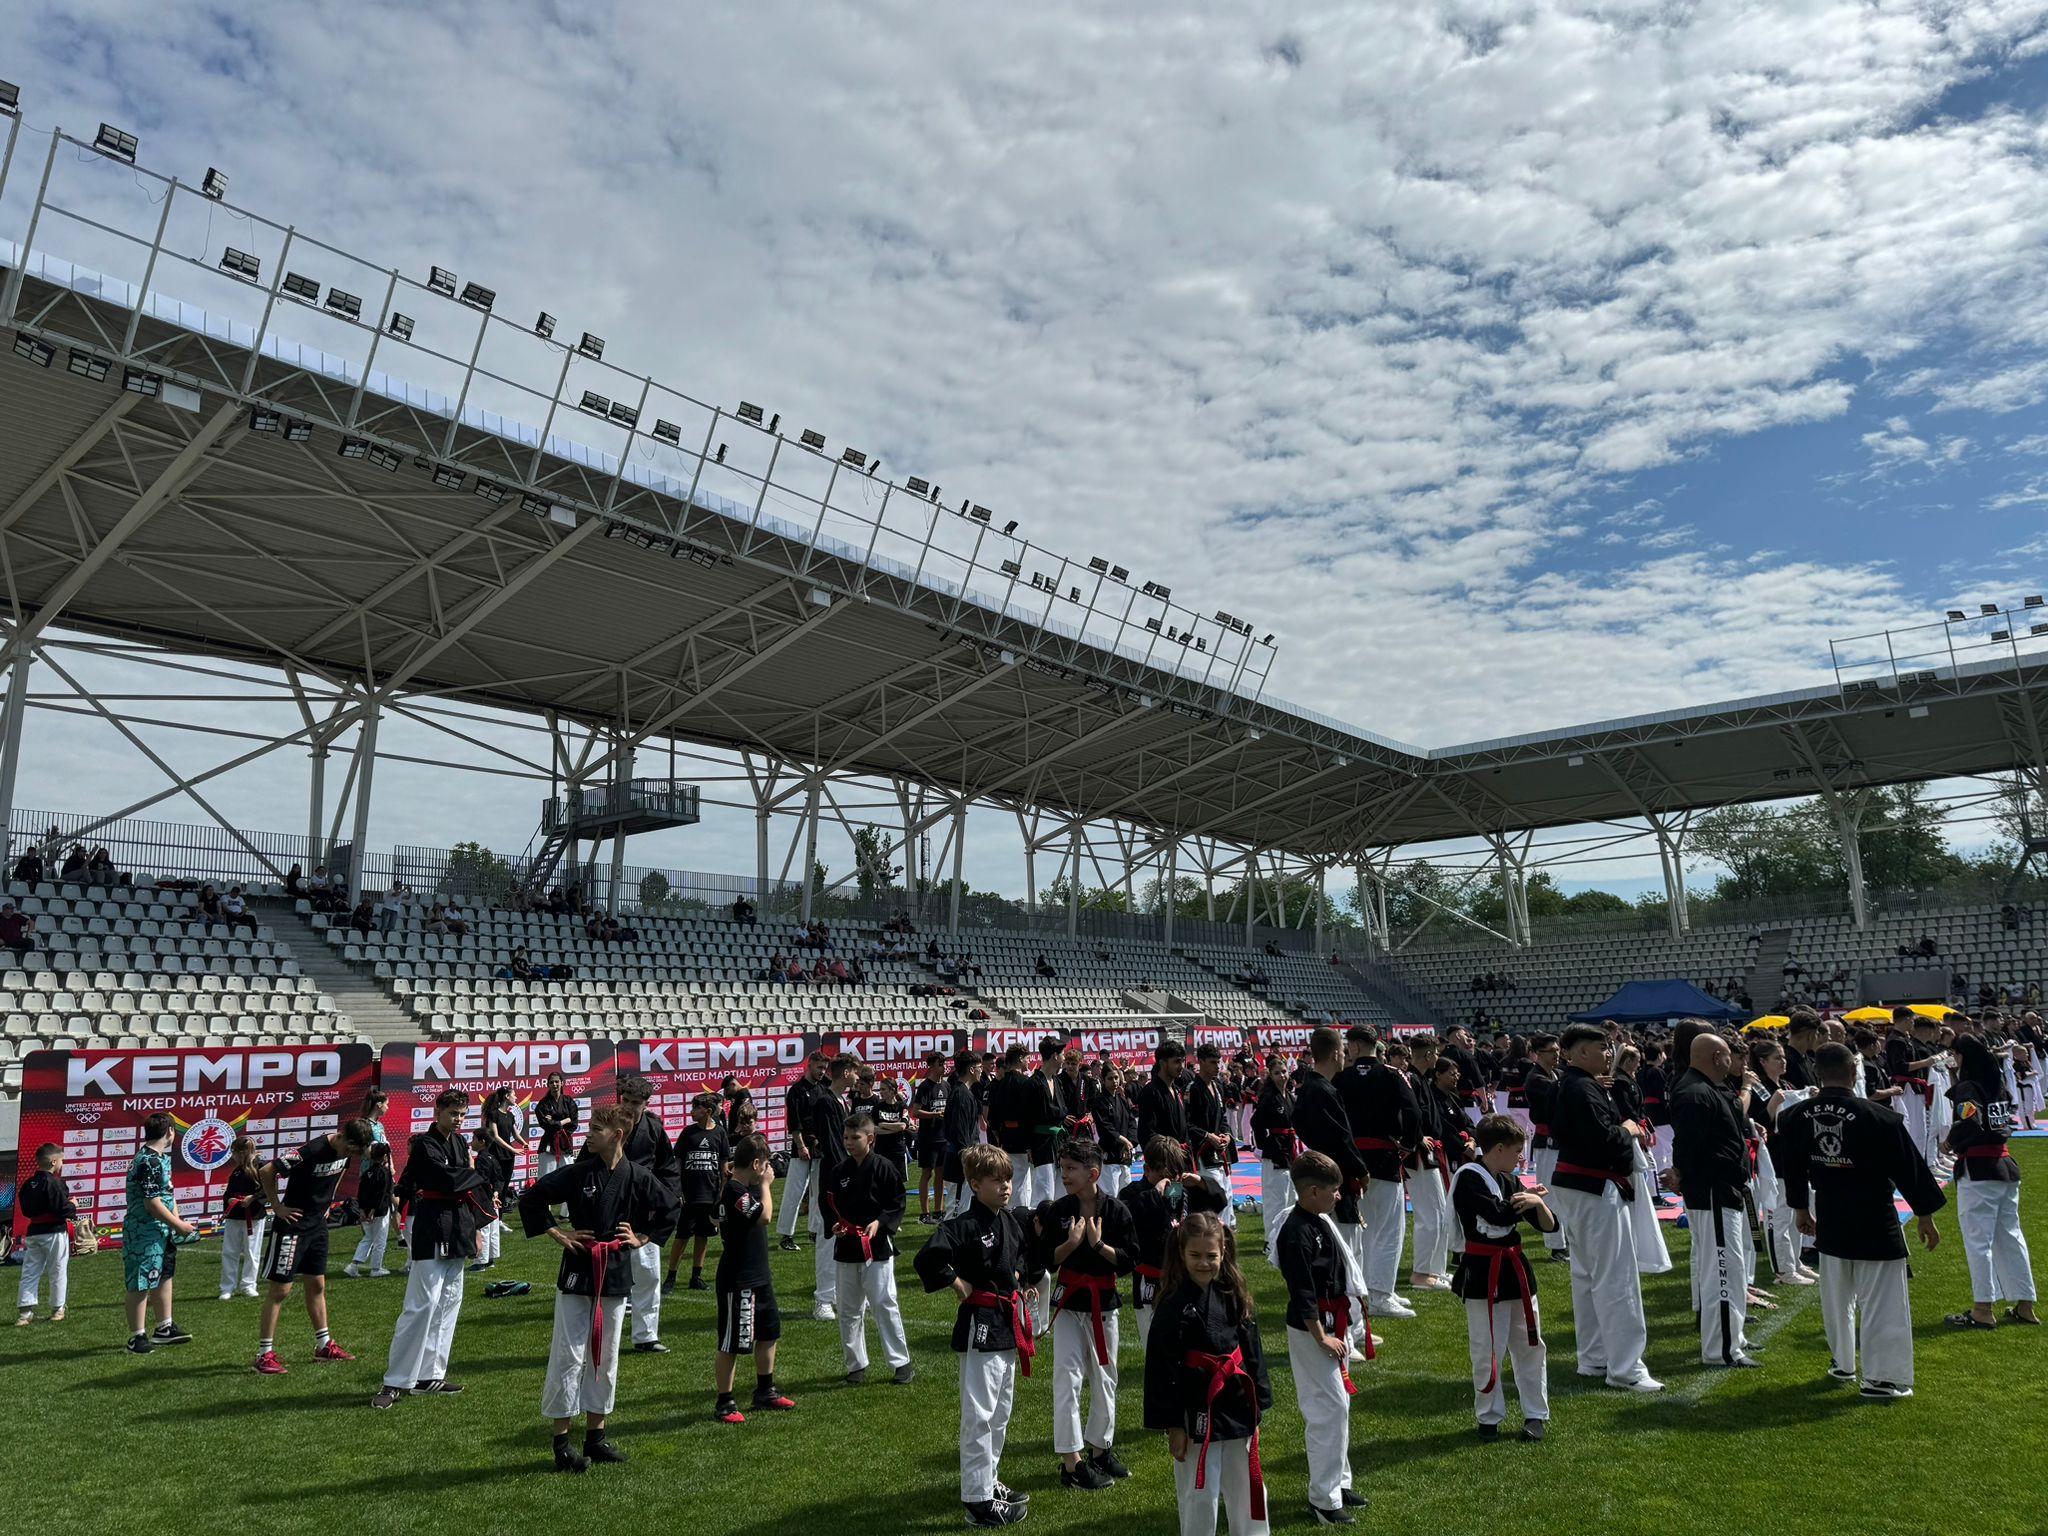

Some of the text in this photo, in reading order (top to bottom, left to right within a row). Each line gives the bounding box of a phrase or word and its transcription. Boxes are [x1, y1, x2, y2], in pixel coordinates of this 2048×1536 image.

[840, 1035, 955, 1061] KEMPO
[1081, 1030, 1159, 1051] KEMPO
[1194, 1030, 1242, 1048] KEMPO
[413, 1043, 590, 1080] KEMPO
[639, 1037, 804, 1071] KEMPO
[67, 1052, 340, 1096] KEMPO
[674, 1072, 706, 1082] MIXED
[708, 1069, 751, 1080] MARTIAL
[752, 1067, 777, 1077] ARTS
[887, 1062, 917, 1070] MARTIAL
[449, 1079, 548, 1092] MIXED MARTIAL AR
[123, 1091, 294, 1111] MIXED MARTIAL ARTS
[1803, 1104, 1856, 1121] KEMPO
[314, 1157, 348, 1173] KEMP
[688, 1152, 717, 1160] KEMPO
[1811, 1154, 1853, 1165] ROMANIA
[276, 1235, 292, 1275] KEMP
[1717, 1249, 1729, 1298] KEMPO
[738, 1288, 752, 1348] KEMPO
